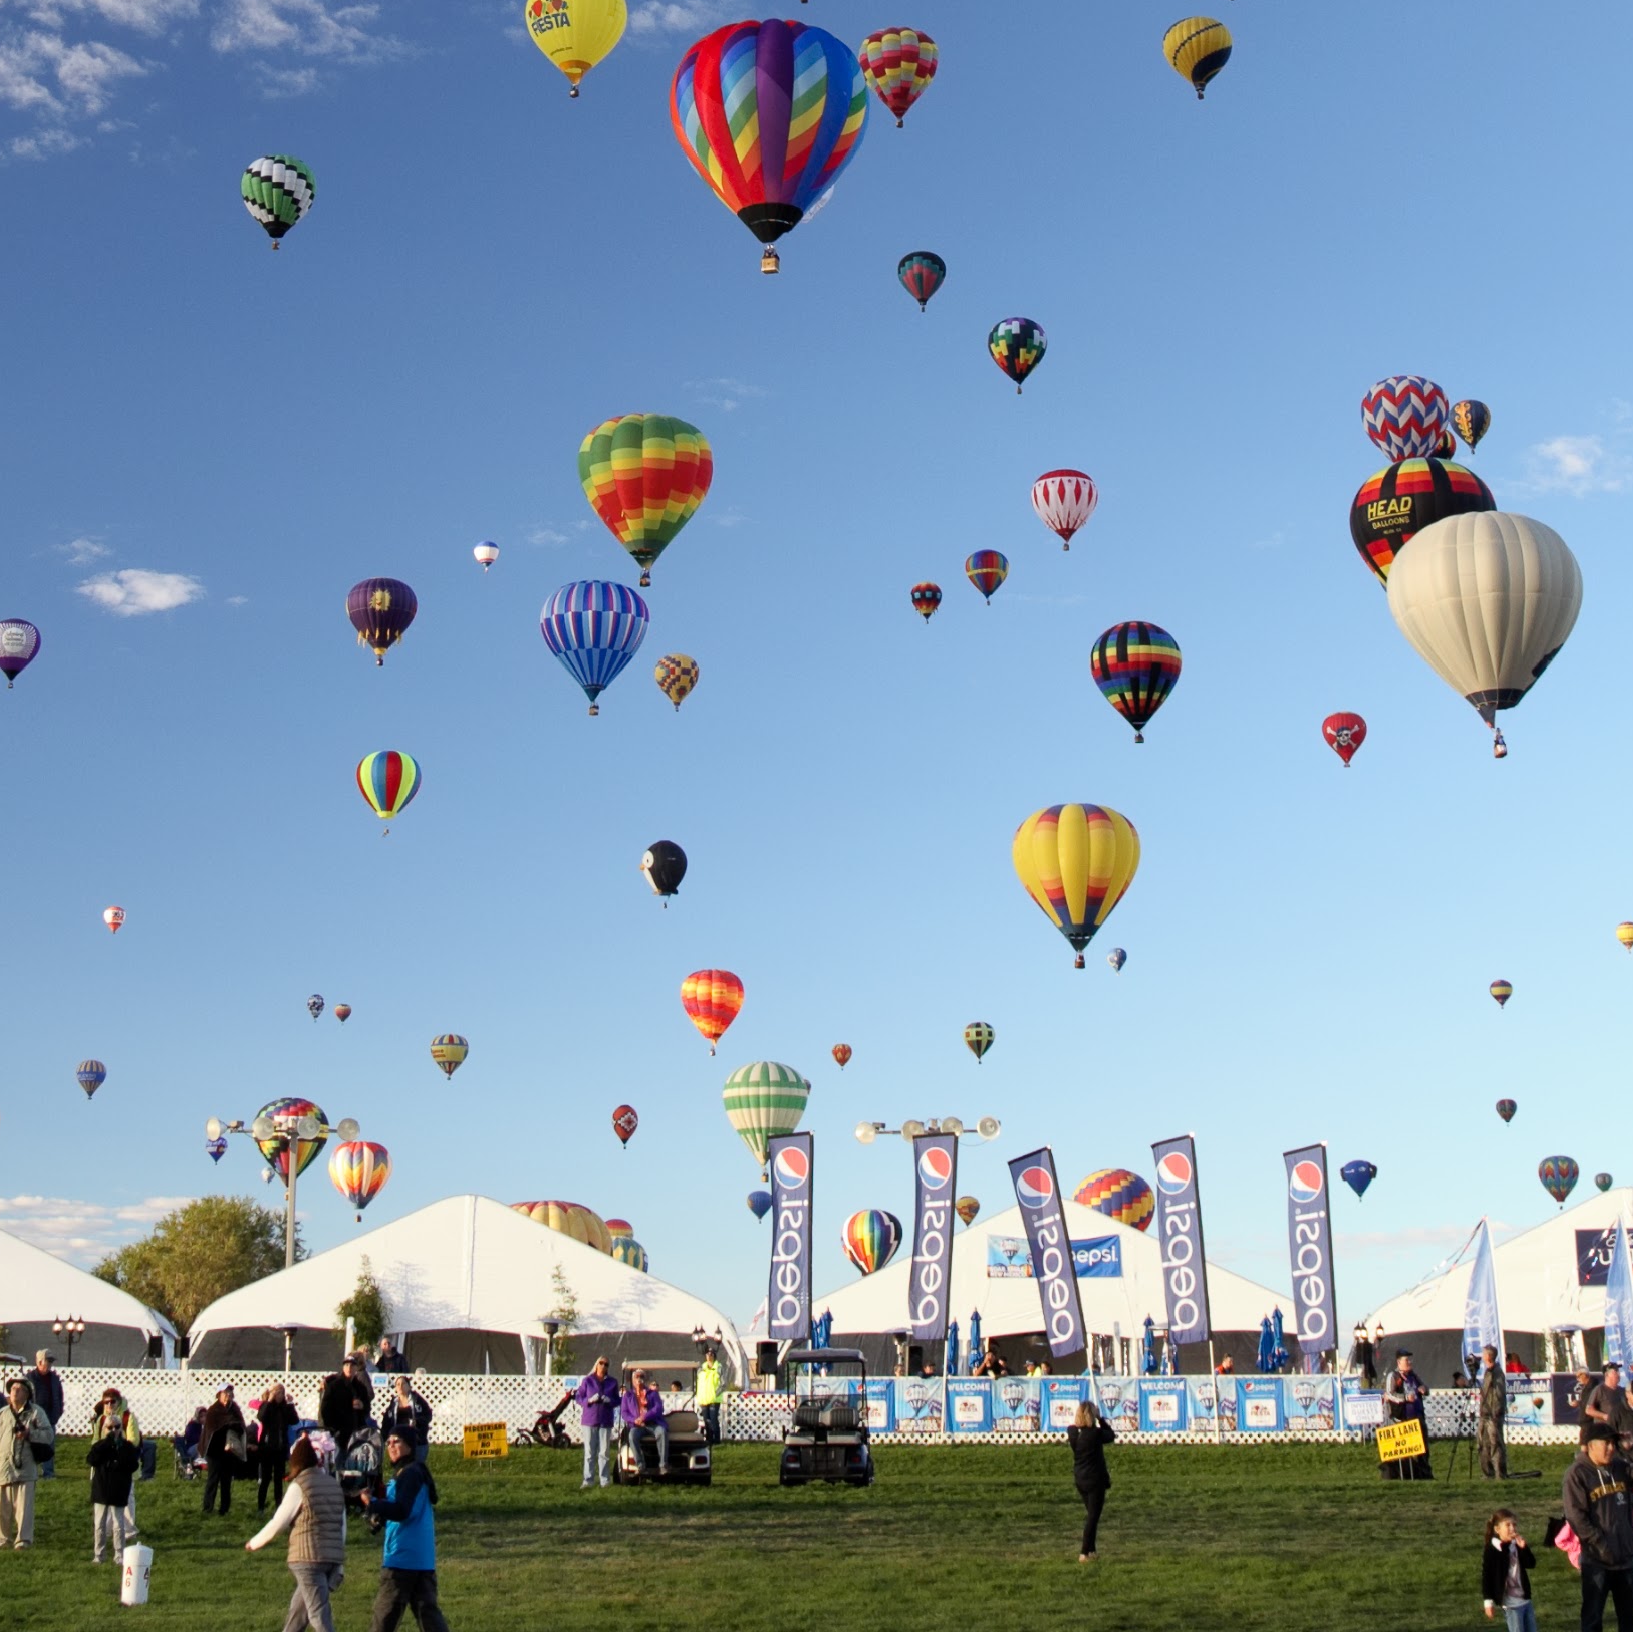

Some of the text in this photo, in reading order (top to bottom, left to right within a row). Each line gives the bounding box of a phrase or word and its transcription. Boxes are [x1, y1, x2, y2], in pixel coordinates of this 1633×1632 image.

[1367, 496, 1412, 519] HEAD
[947, 1382, 990, 1392] WELCOME
[1139, 1381, 1185, 1391] WELCOME
[464, 1423, 506, 1432] PEDESTRIANS
[1379, 1422, 1418, 1440] FIRE LANE
[477, 1432, 493, 1440] ONLY
[1395, 1439, 1406, 1447] NO
[1383, 1445, 1422, 1458] PARKING!
[126, 1566, 132, 1576] A
